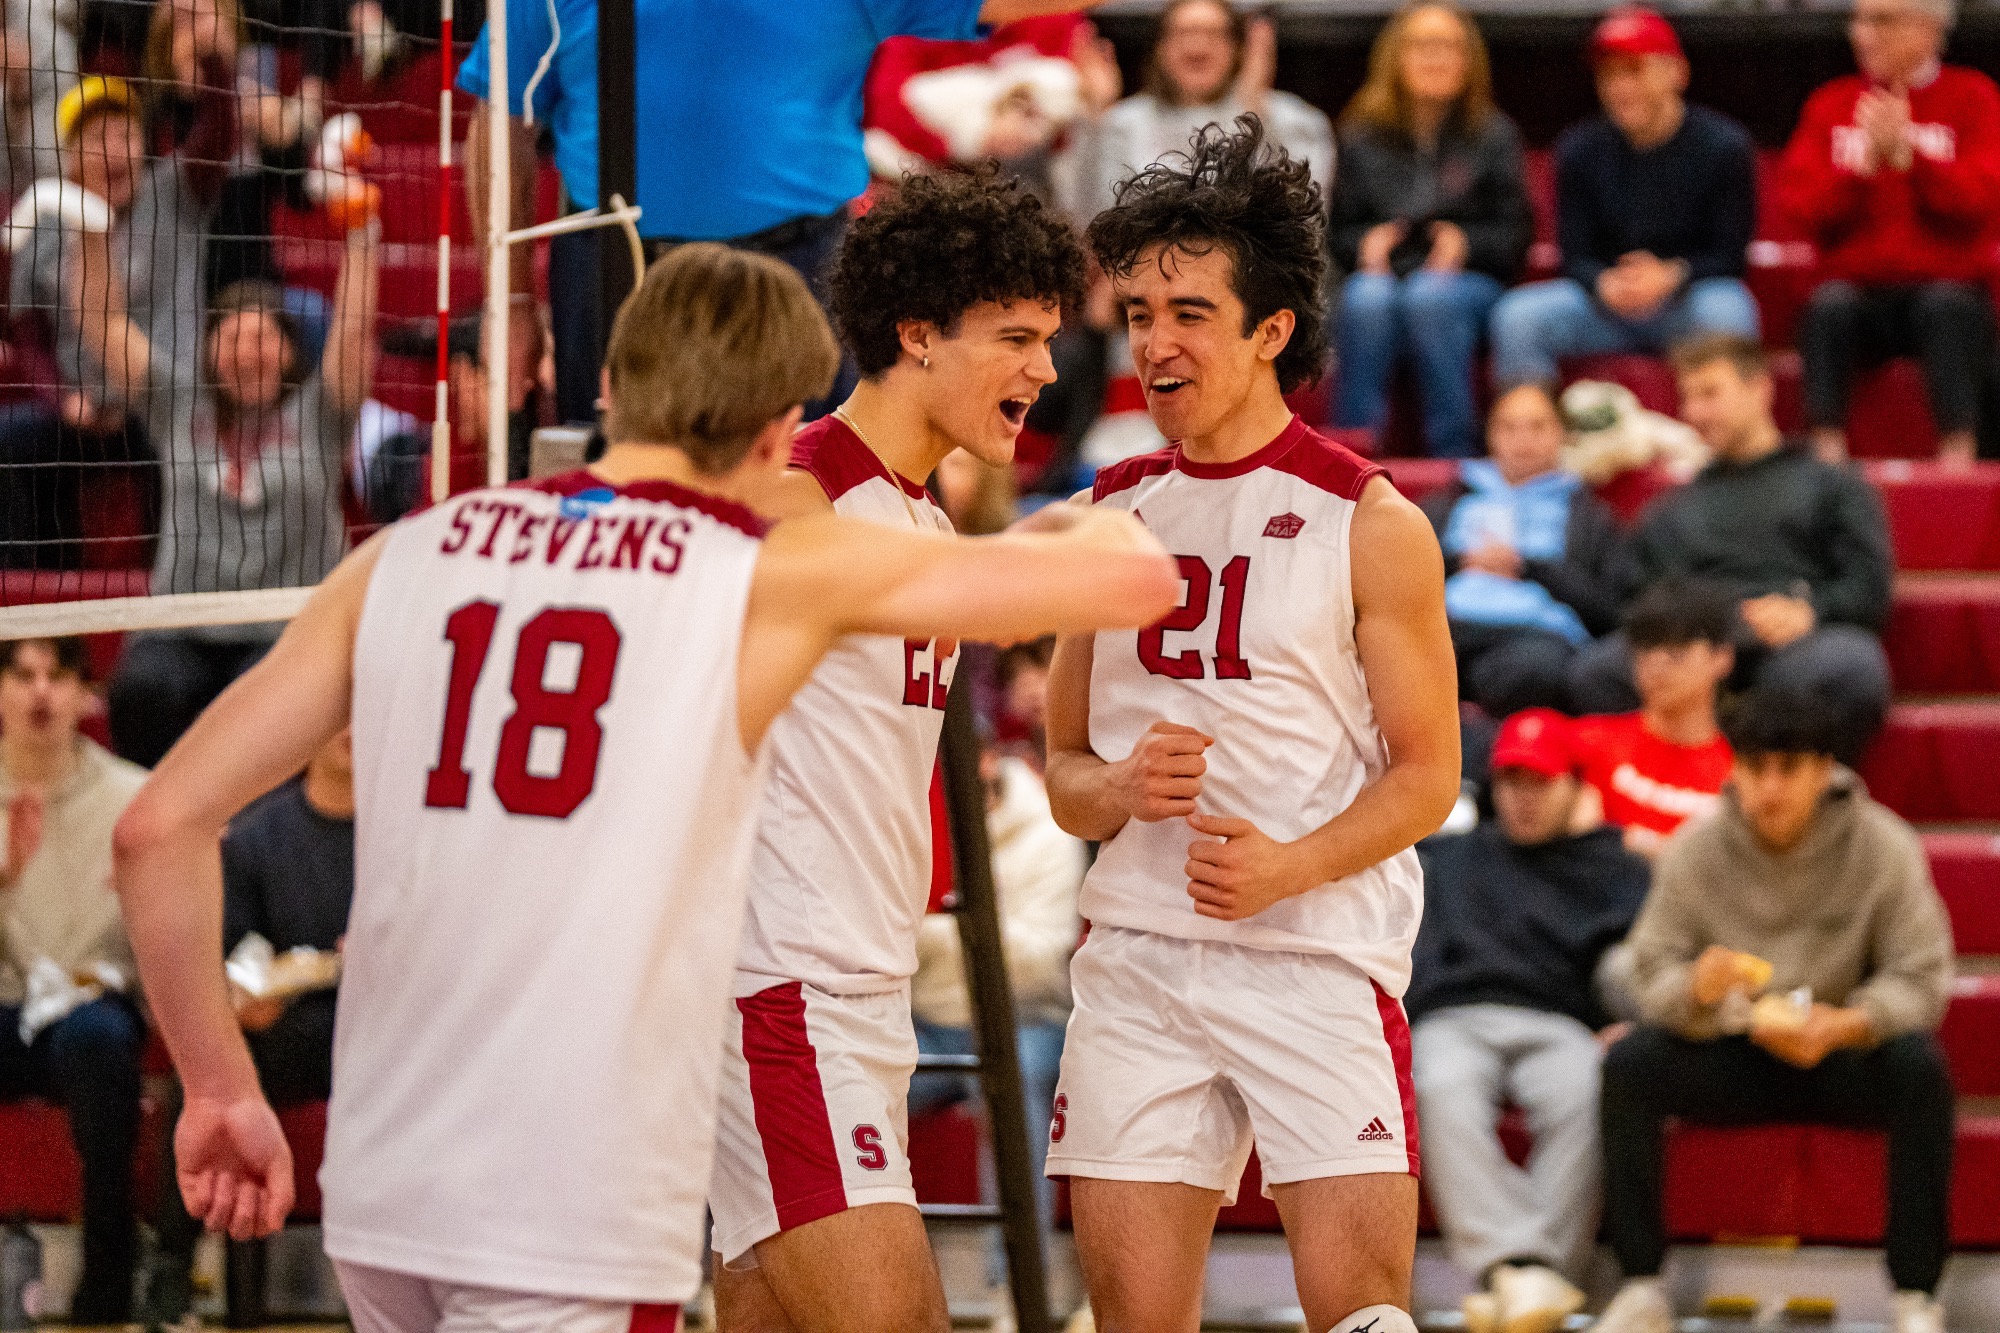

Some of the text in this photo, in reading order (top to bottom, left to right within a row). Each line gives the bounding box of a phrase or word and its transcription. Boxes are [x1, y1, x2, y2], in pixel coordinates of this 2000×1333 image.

[441, 500, 692, 574] STEVENS
[1137, 554, 1251, 680] 21
[424, 599, 622, 820] 18
[852, 1124, 888, 1171] S
[1357, 1131, 1393, 1141] adidas
